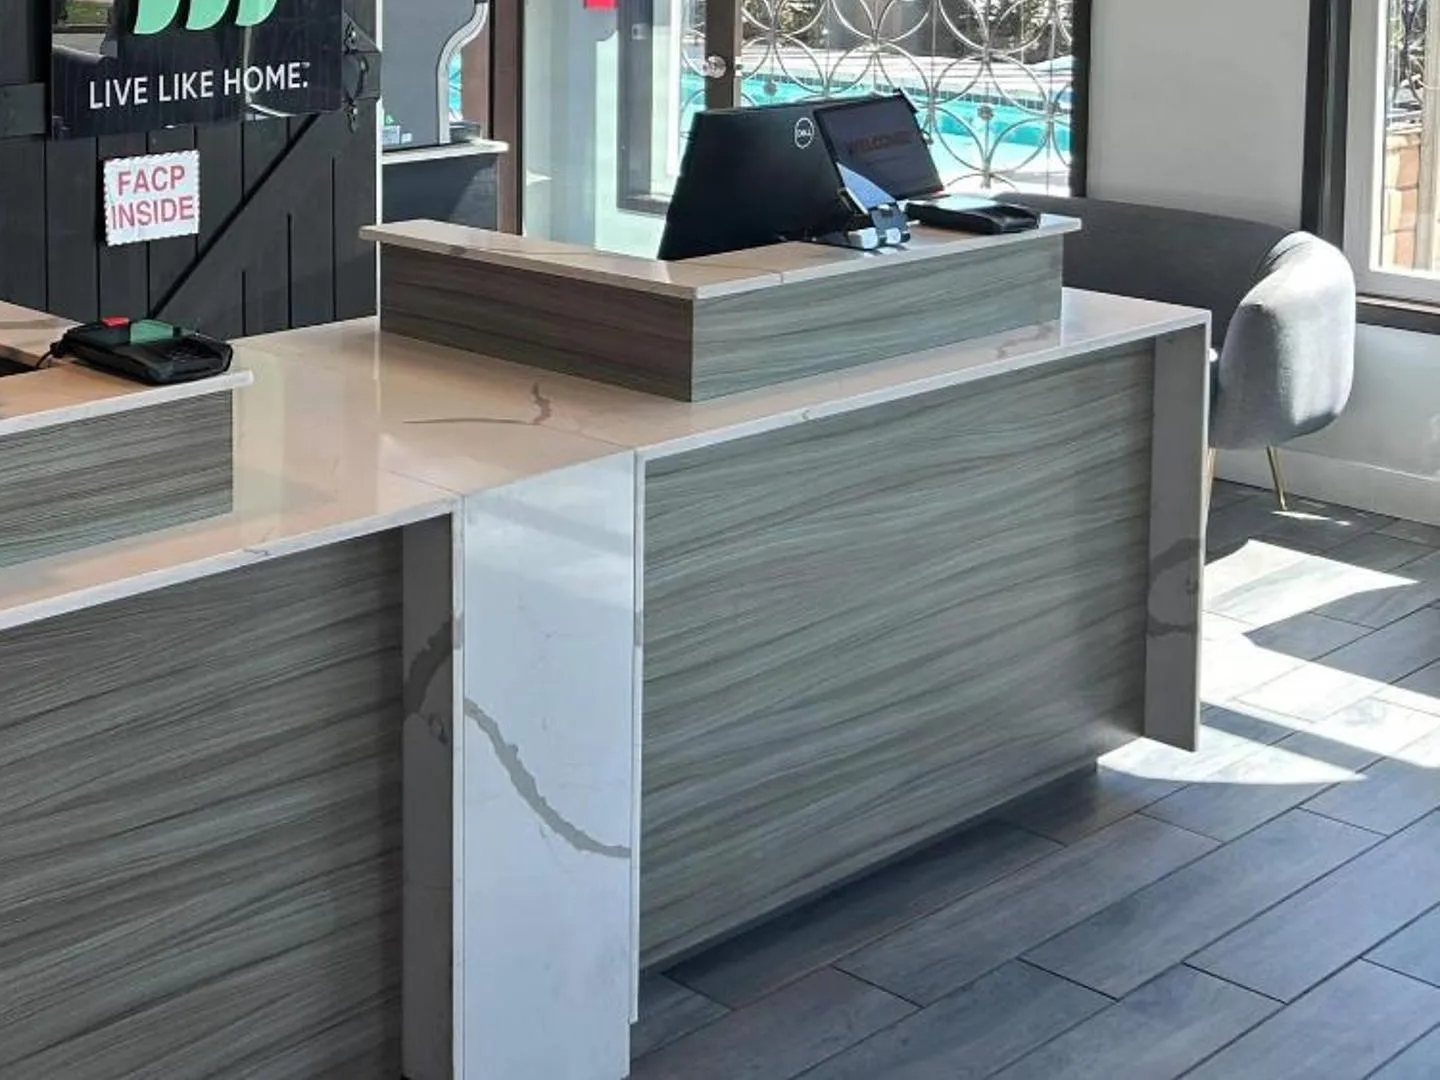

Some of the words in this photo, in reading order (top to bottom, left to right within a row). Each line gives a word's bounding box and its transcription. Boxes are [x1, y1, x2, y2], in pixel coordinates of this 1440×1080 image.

[89, 77, 148, 109] LIVE
[158, 70, 214, 102] LIKE
[118, 165, 185, 196] FACP
[112, 196, 194, 229] INSIDE
